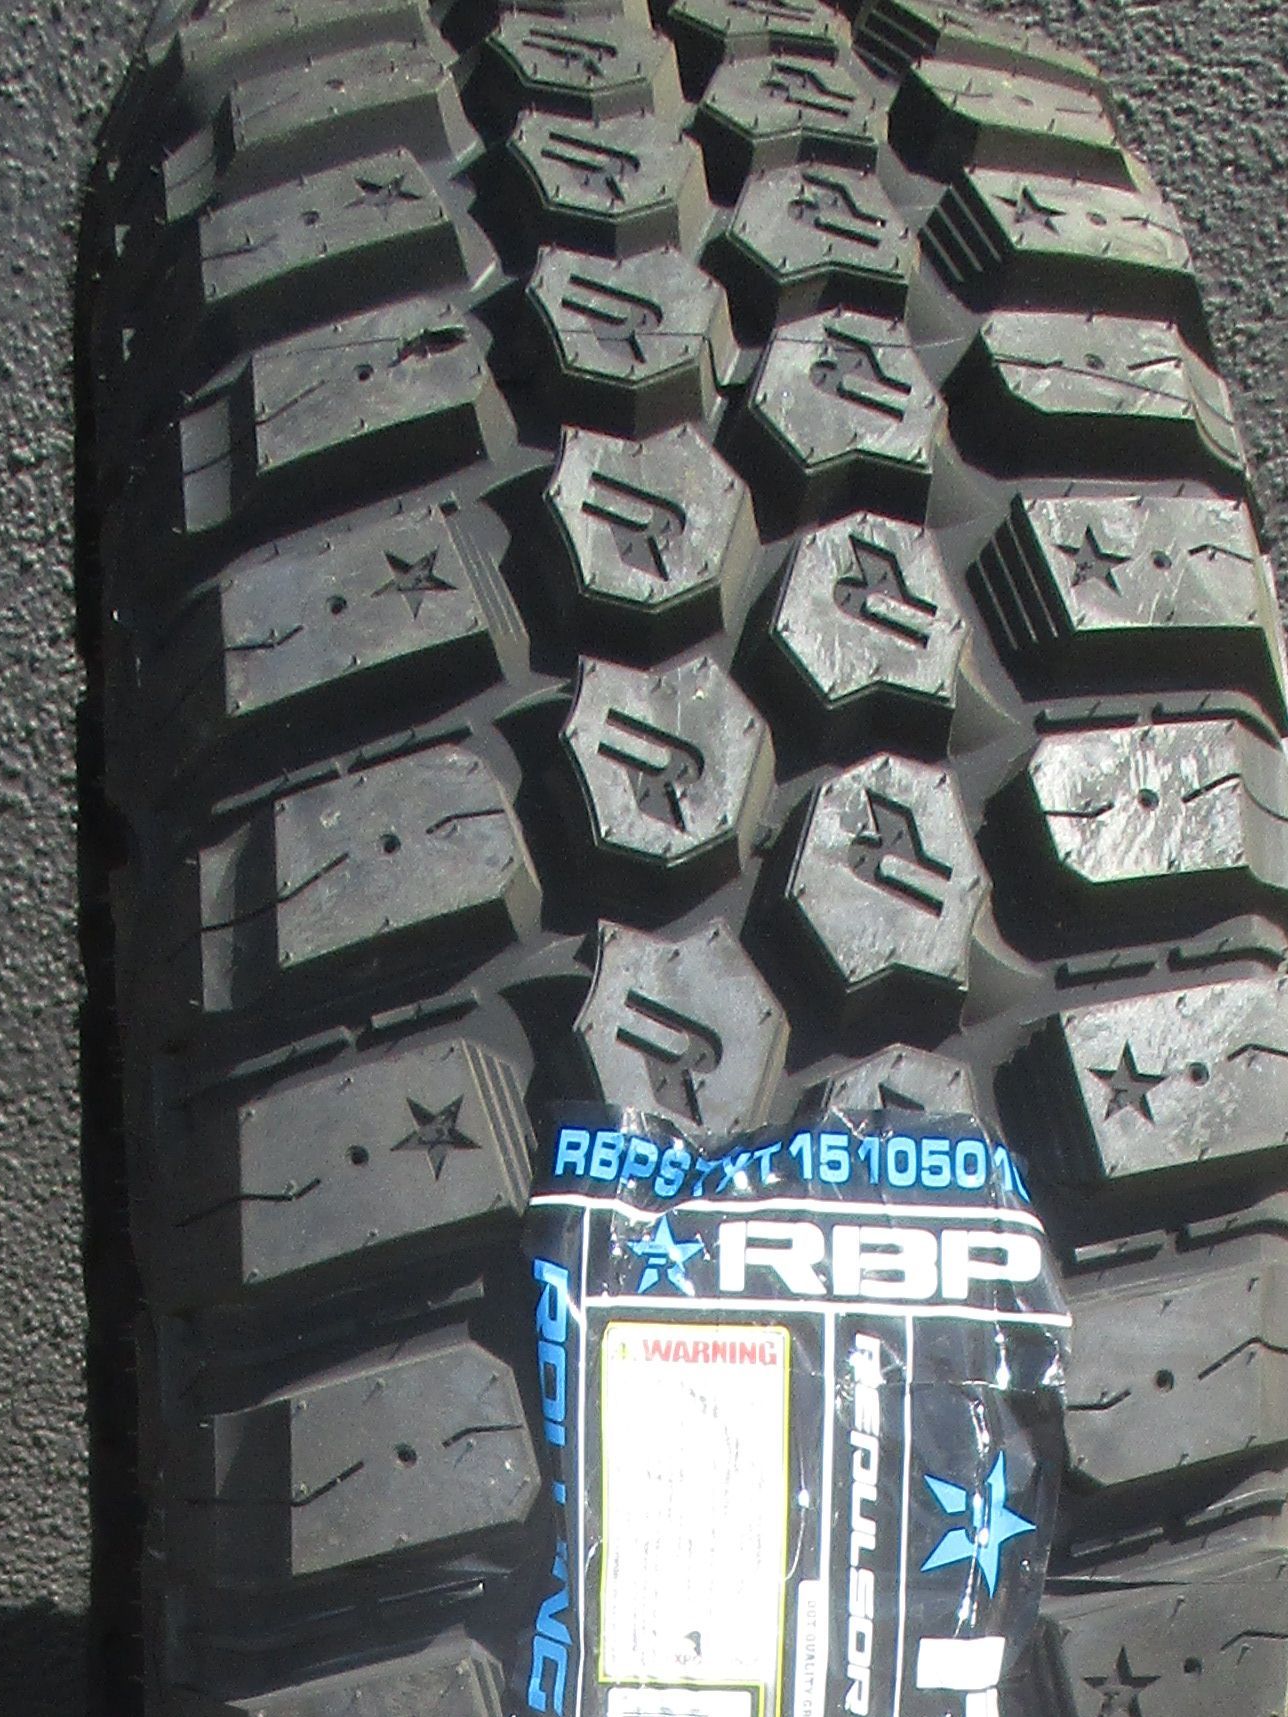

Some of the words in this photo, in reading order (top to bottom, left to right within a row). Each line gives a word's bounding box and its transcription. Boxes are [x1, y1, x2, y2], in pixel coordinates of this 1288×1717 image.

[718, 1221, 1042, 1302] RBP
[643, 1337, 778, 1366] WARNING
[840, 1333, 881, 1716] REPULSOR
